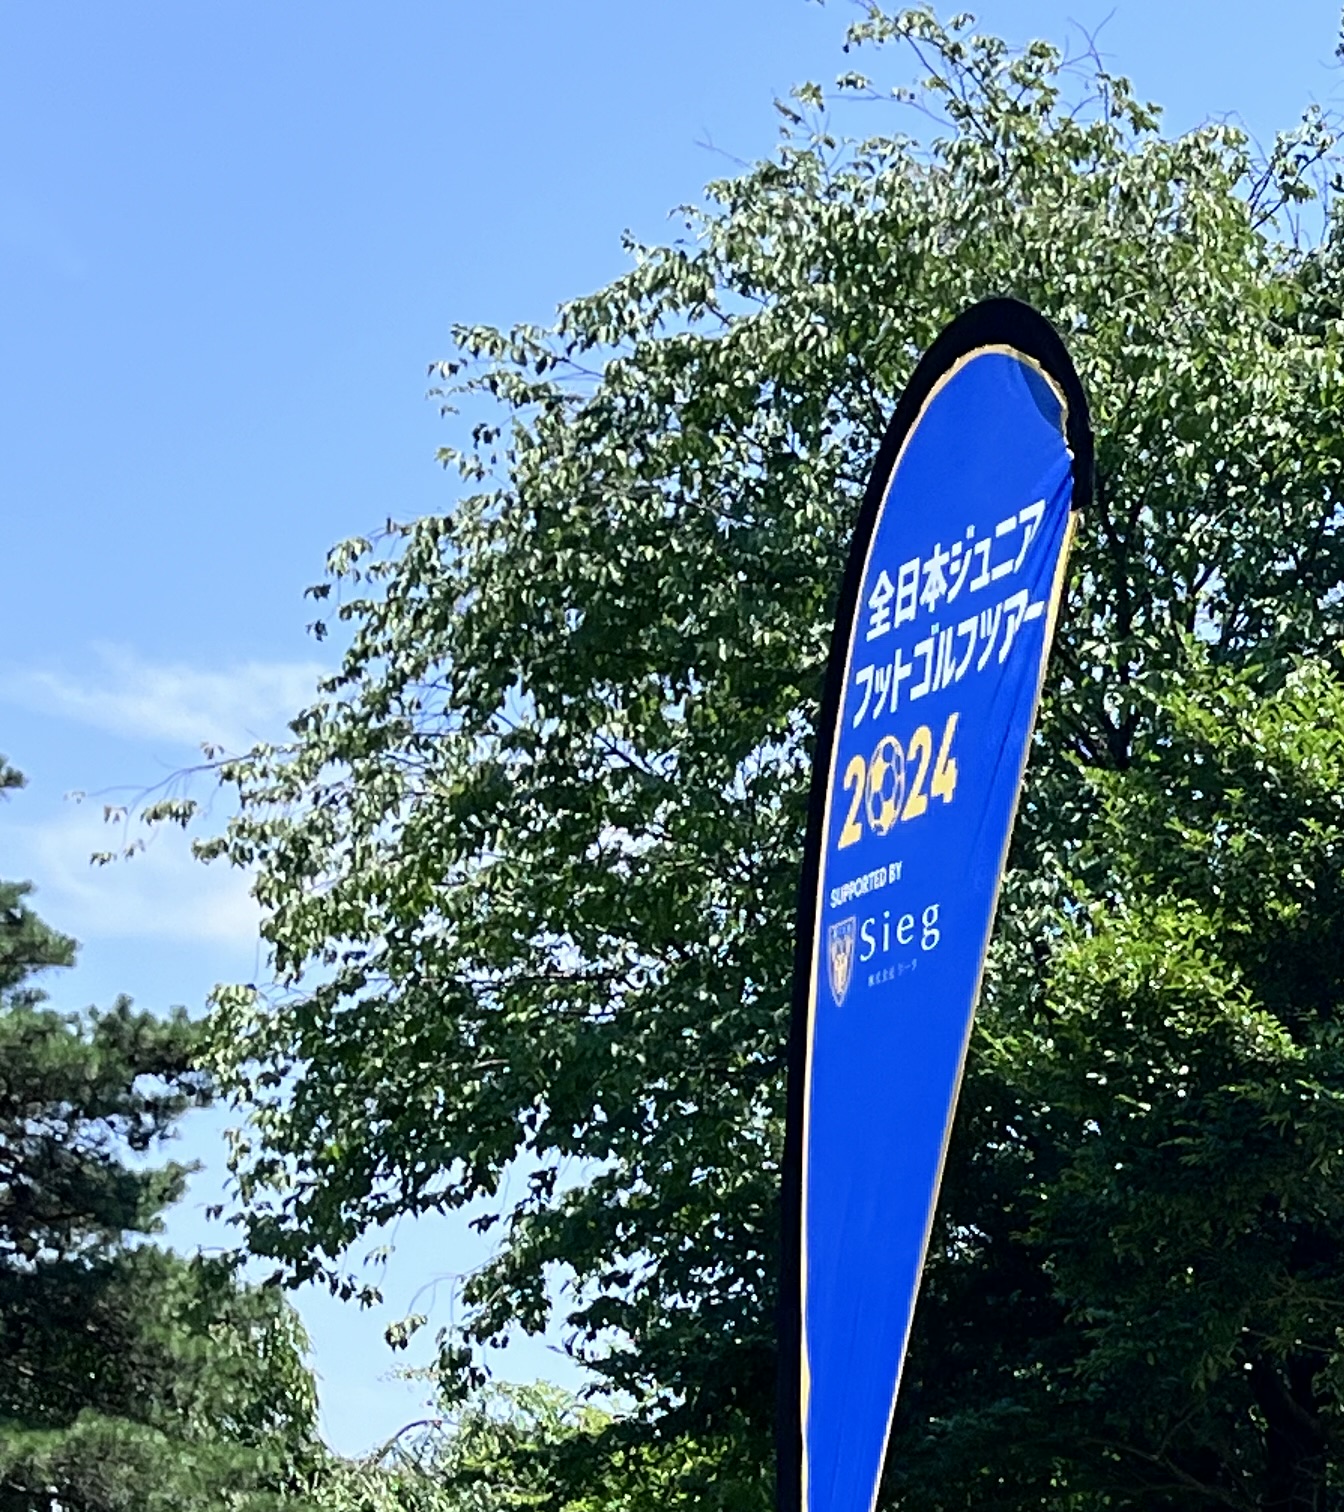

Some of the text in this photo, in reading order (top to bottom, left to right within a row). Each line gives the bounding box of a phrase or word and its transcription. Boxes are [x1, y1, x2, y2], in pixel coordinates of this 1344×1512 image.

[867, 500, 1046, 642] 全日本ジュニア
[852, 588, 1045, 729] フットゴルフツアー
[837, 712, 960, 850] 2024
[830, 860, 903, 908] SUPPORTED BY
[860, 903, 940, 962] Sieg
